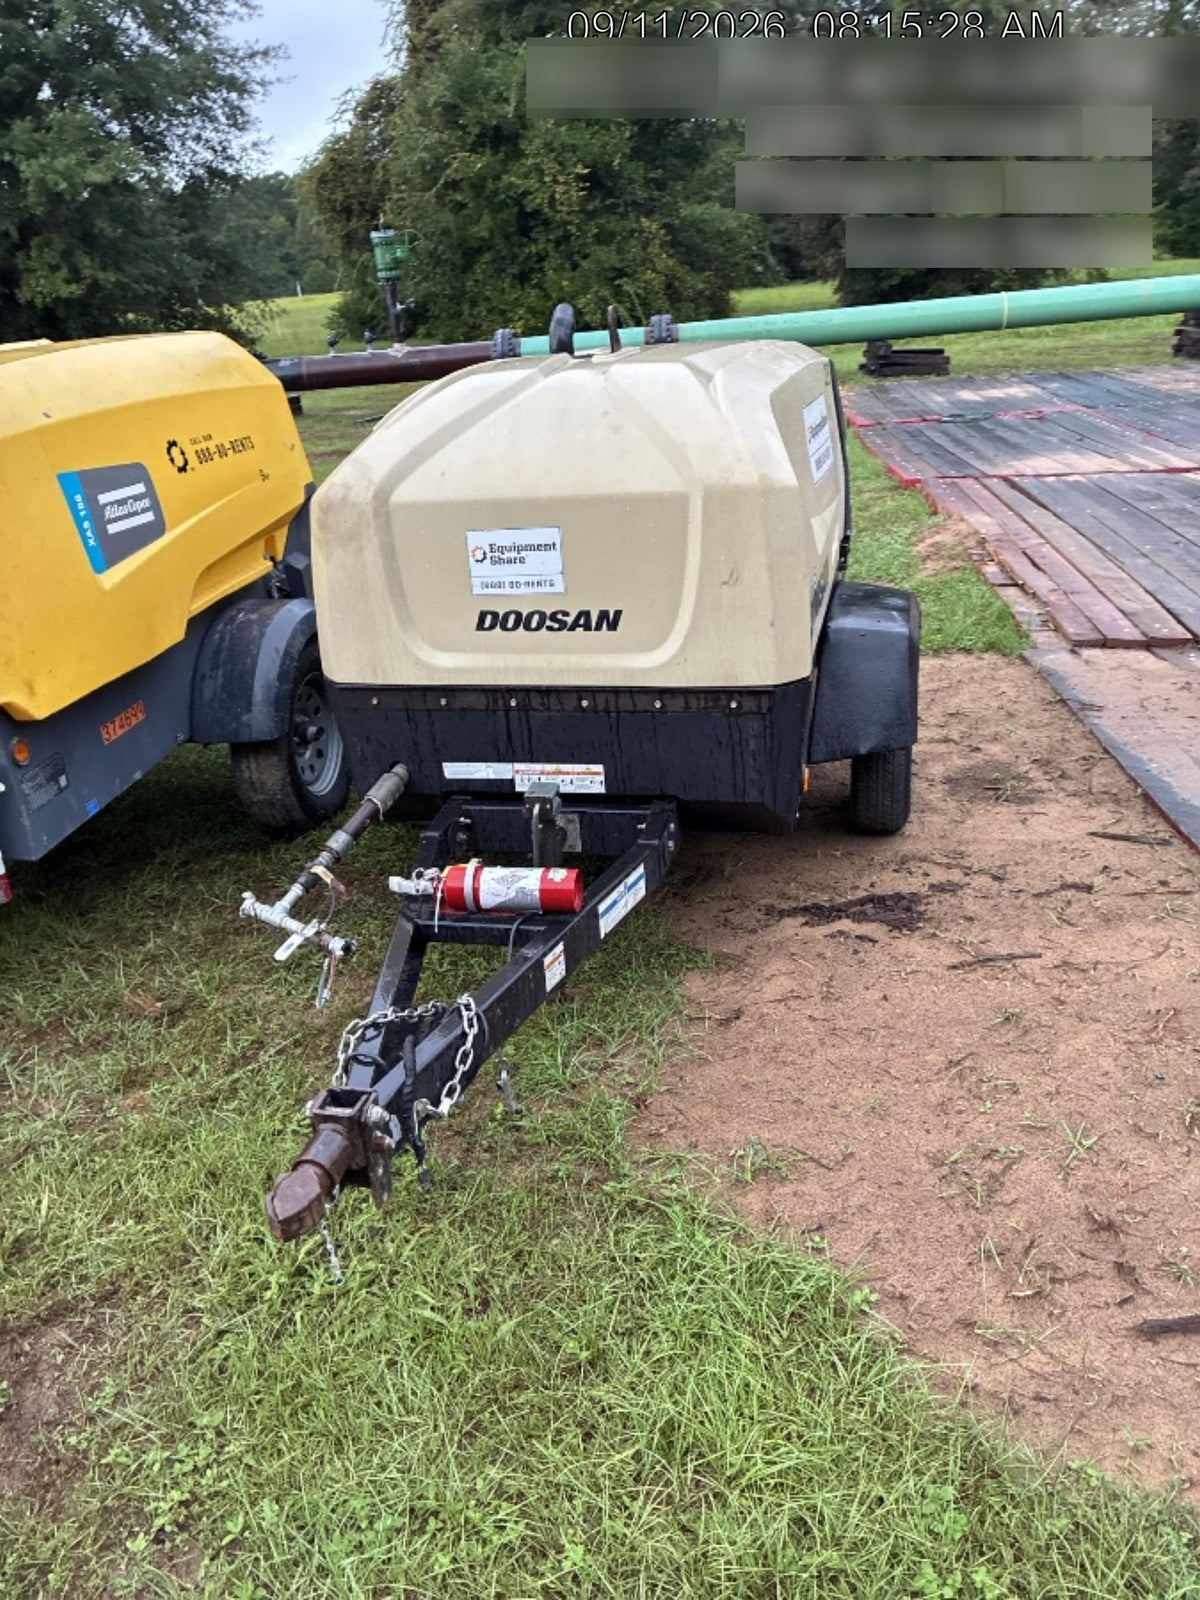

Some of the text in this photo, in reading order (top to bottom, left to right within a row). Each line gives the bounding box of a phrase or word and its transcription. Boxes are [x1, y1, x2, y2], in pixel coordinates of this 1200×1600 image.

[488, 541, 557, 555] Equipment
[489, 554, 526, 566] Share
[475, 609, 623, 632] DOOSAN
